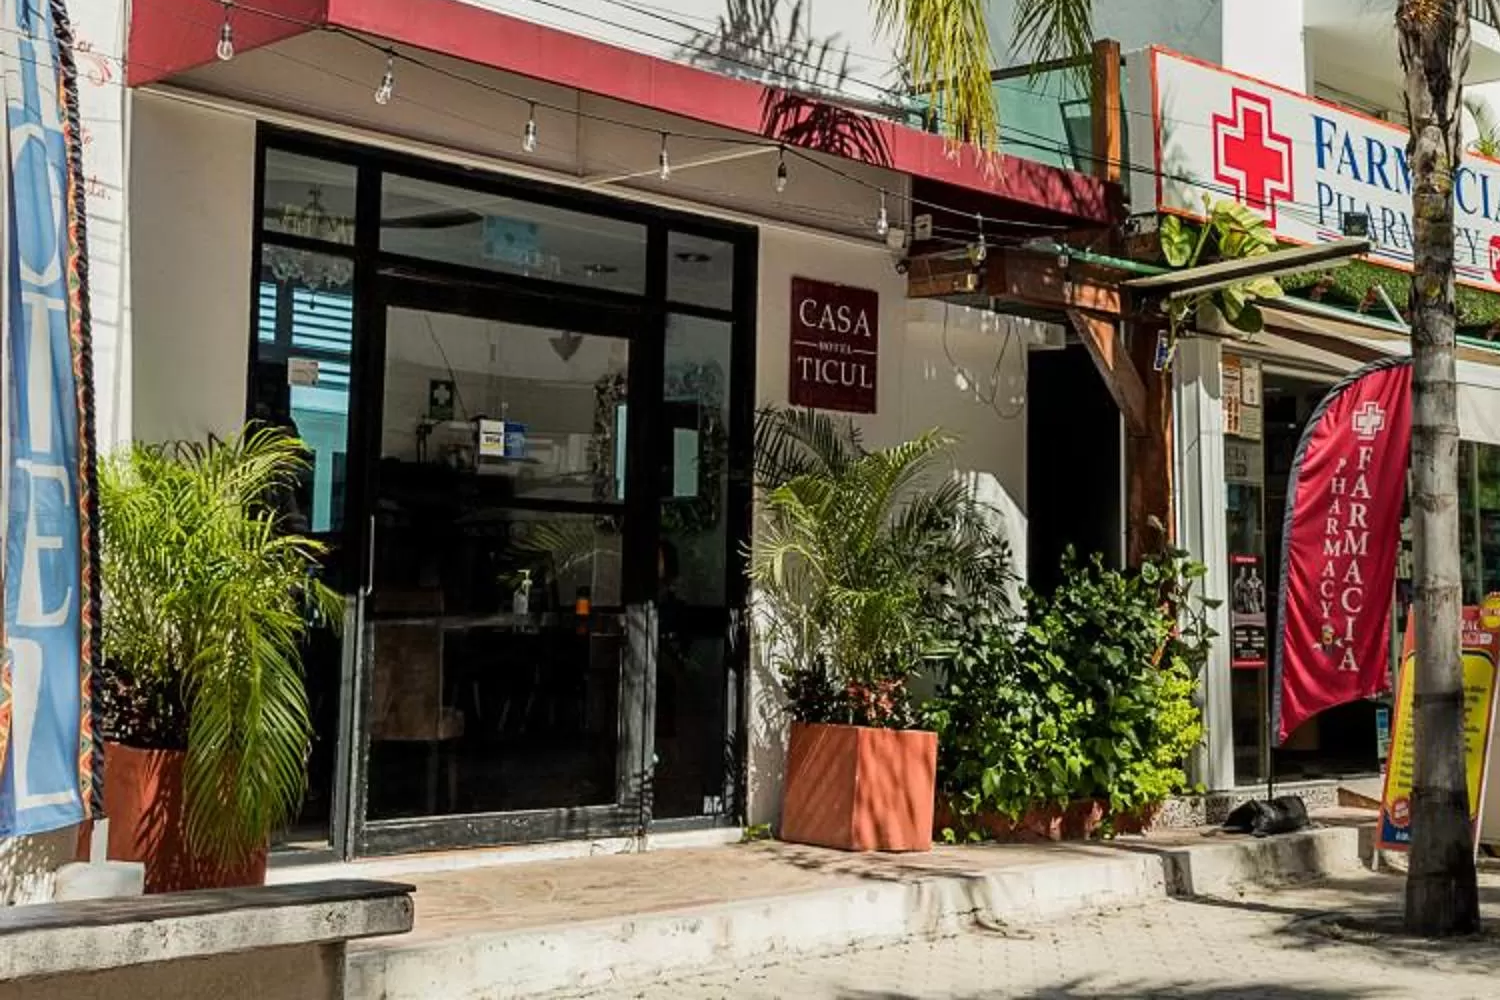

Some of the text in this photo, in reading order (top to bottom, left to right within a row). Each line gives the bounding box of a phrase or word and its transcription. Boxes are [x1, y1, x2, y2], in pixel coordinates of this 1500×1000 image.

[1316, 181, 1480, 265] PHARMY
[799, 298, 872, 338] CASA
[797, 355, 874, 389] TICUL
[1320, 457, 1347, 619] PHARMACY
[1337, 445, 1373, 672] FARMACIA
